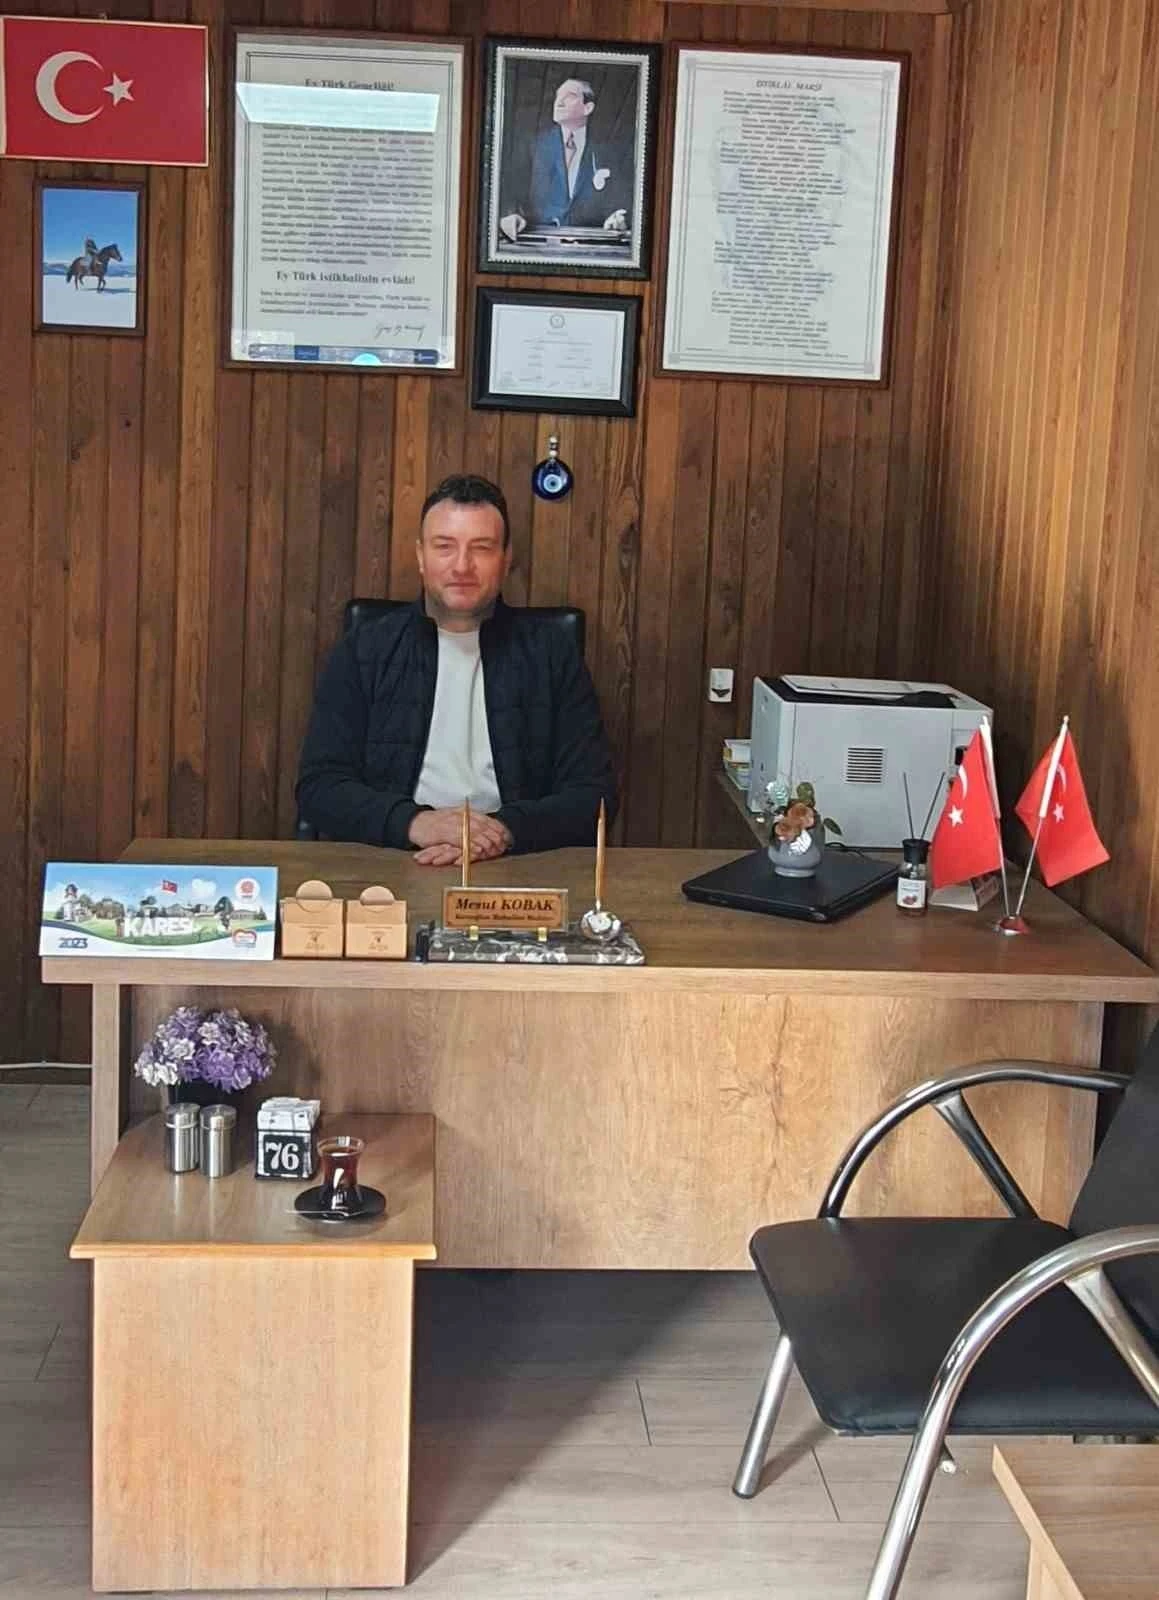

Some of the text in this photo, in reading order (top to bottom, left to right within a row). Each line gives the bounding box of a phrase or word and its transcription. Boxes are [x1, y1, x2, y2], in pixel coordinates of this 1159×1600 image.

[292, 271, 316, 282] Türk
[455, 898, 555, 910] Mesut KOBAK
[58, 937, 88, 949] 2023
[265, 1142, 299, 1171] 76
